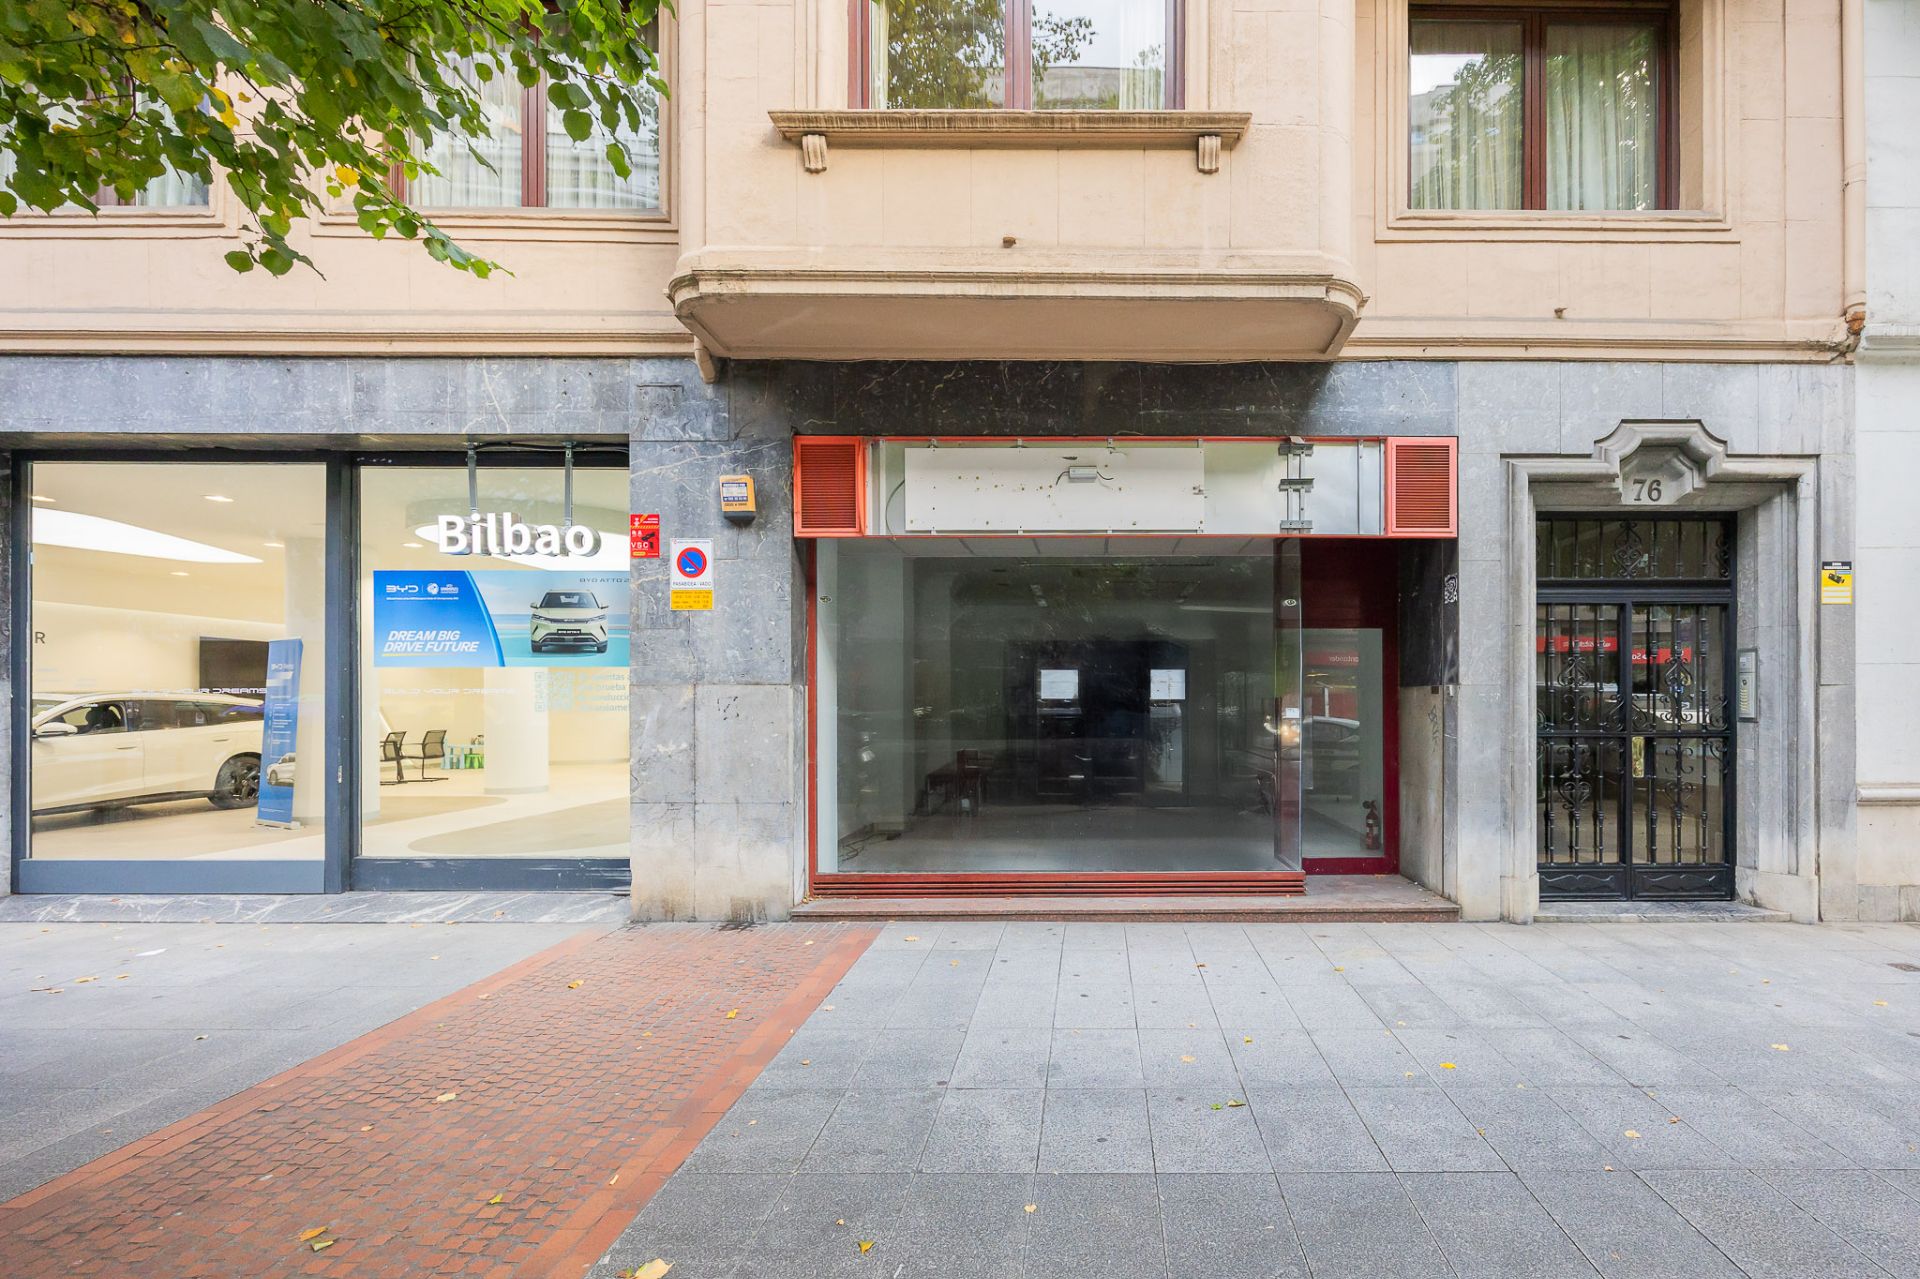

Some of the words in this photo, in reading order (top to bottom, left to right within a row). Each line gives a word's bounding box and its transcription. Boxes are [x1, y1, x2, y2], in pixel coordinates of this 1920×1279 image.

[1633, 478, 1662, 502] 76
[437, 511, 601, 557] Bilbao
[385, 584, 419, 593] BYD
[34, 631, 46, 645] R
[388, 630, 437, 641] DREAM
[437, 630, 461, 641] BIG
[383, 641, 424, 653] DRIVE
[424, 641, 480, 653] FUTURE
[211, 687, 267, 695] DREAMS
